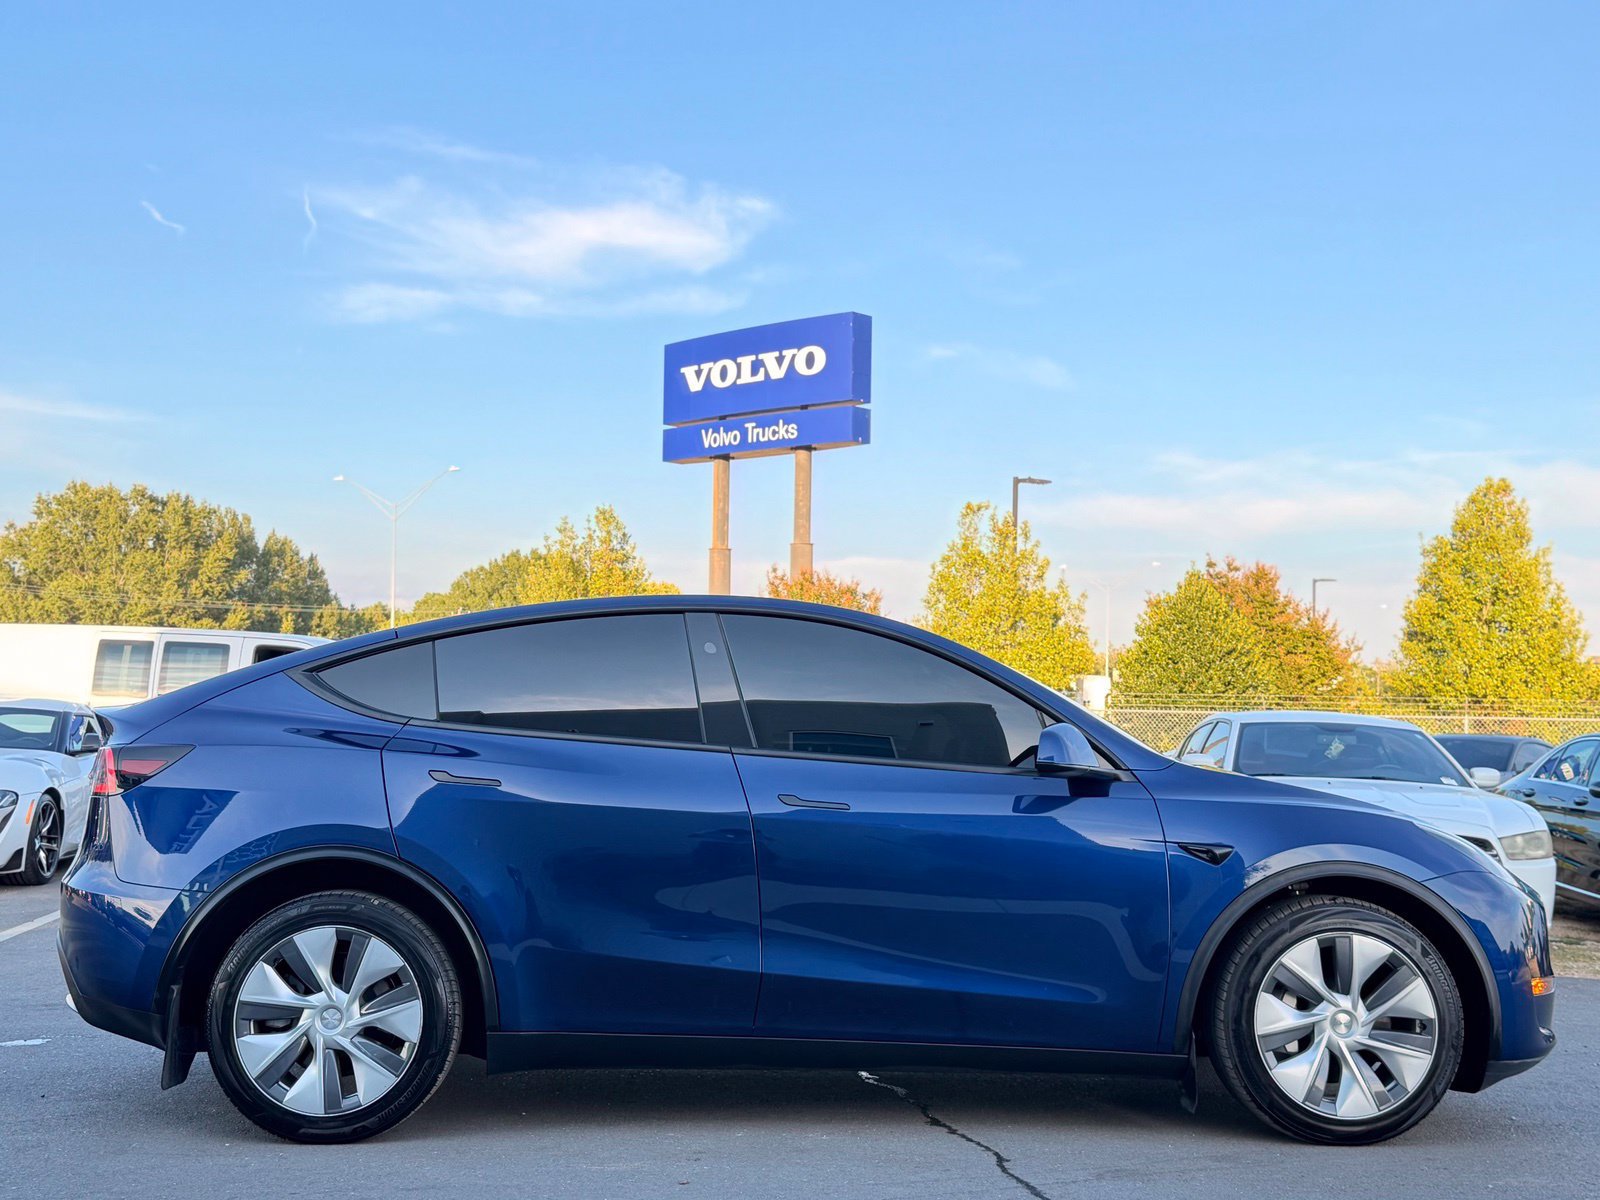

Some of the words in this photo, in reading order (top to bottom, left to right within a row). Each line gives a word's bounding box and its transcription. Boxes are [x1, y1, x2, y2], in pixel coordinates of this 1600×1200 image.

[680, 345, 827, 393] VOLVO
[701, 427, 741, 448] Volvo
[744, 419, 798, 443] Trucks
